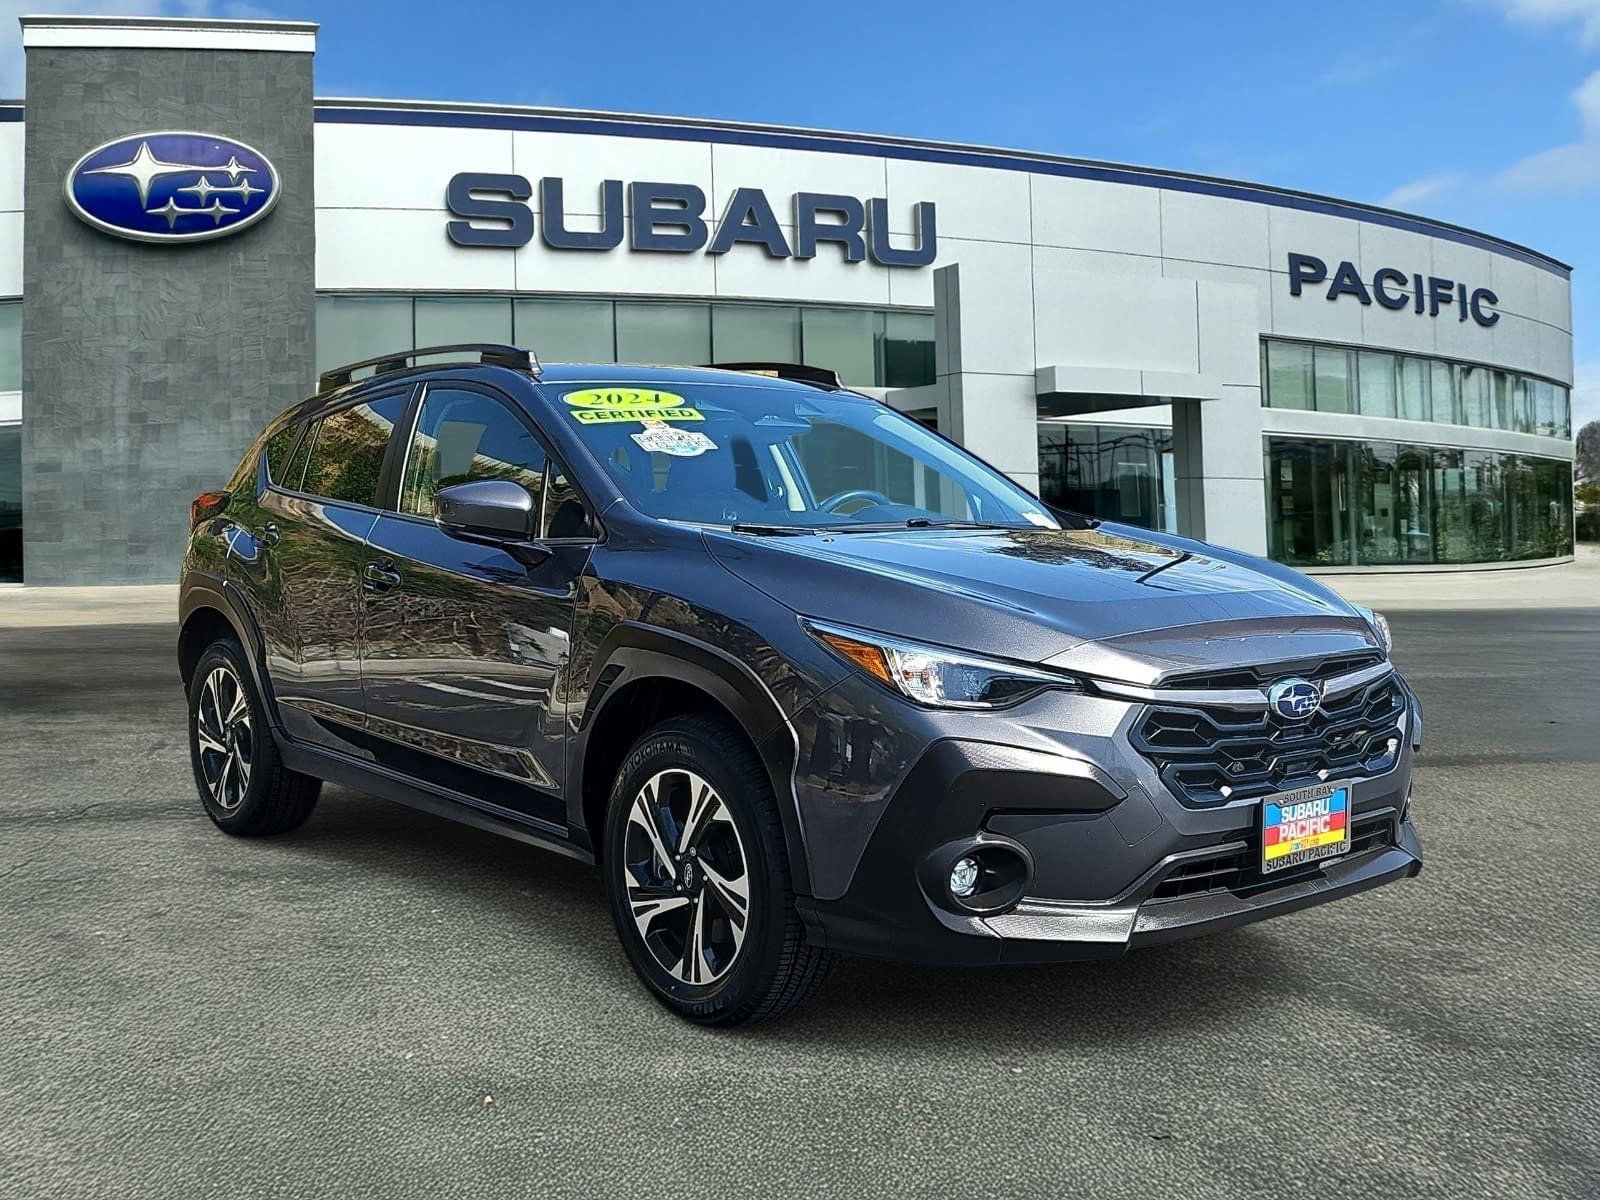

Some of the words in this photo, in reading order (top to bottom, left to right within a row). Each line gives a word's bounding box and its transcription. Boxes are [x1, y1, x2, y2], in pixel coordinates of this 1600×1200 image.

[446, 171, 937, 268] SUBARU
[1288, 252, 1500, 328] PACIFIC
[591, 392, 662, 405] 2024
[579, 409, 694, 420] CERTIFIED
[1284, 788, 1313, 803] SOUTH
[1315, 785, 1333, 797] BAY
[1281, 798, 1331, 823] SUBARU
[1279, 815, 1330, 841] PACIFIC
[1266, 853, 1305, 870] SUBARU
[1309, 842, 1346, 858] PACIFIC
